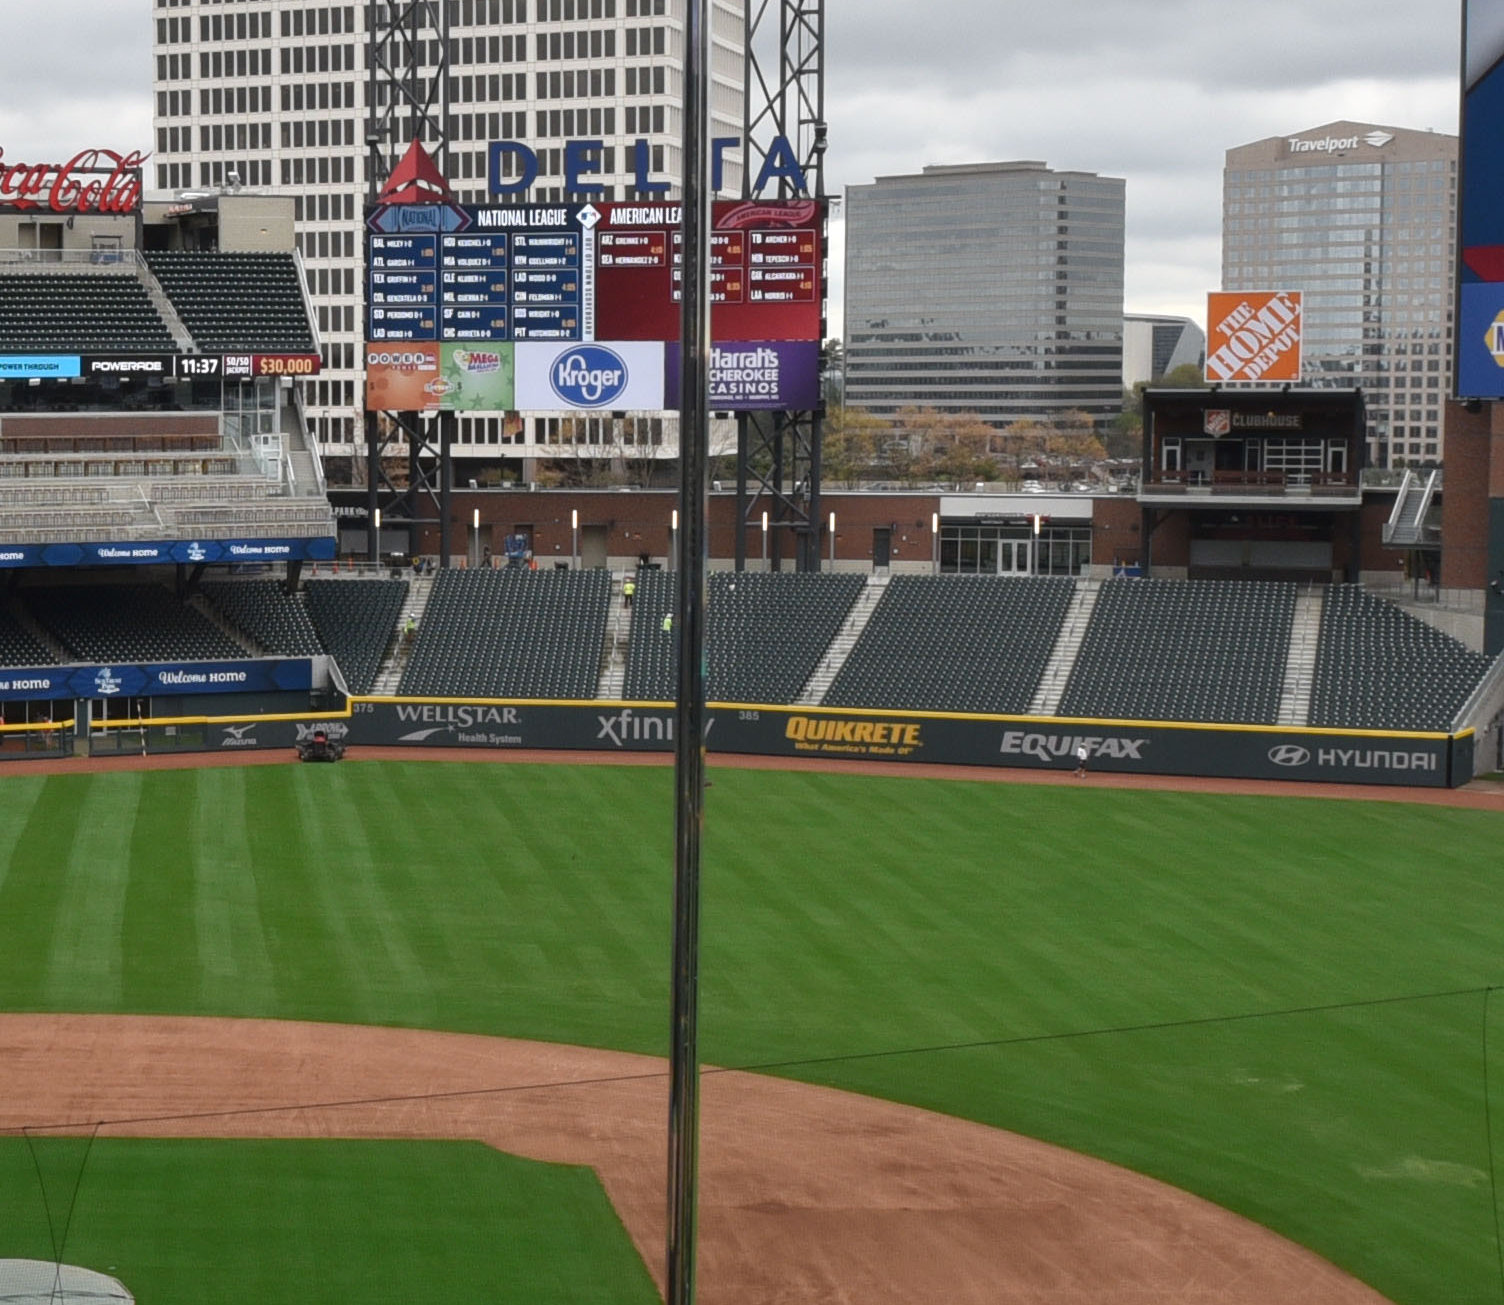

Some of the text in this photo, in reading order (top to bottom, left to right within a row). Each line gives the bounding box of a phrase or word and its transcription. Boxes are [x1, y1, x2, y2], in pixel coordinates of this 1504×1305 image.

[1289, 133, 1358, 154] Travelport
[489, 135, 807, 193] DELTA
[478, 209, 568, 227] NATIONAL LEAGUE
[610, 208, 663, 225] AMERICAN
[1217, 301, 1256, 339] THE
[1206, 292, 1301, 382] HOME
[368, 352, 425, 365] POWER
[469, 351, 499, 364] MEGA
[1242, 325, 1301, 382] DEPOT
[92, 361, 162, 372] POWERADE
[181, 359, 218, 374] 11:37
[226, 356, 313, 375] 50/50 $30,000
[557, 355, 623, 400] Kroger
[709, 369, 779, 382] CHEROKEE
[709, 382, 778, 394] CASINOS
[1232, 415, 1299, 427] CLUBHOUSE
[158, 670, 204, 685] Welcome
[353, 703, 374, 713] 375
[738, 710, 759, 721] 385
[596, 709, 713, 746] xfini
[785, 716, 920, 745] QUIKRETE
[458, 732, 522, 745] Health System
[1000, 731, 1145, 761] EQUIFAX
[1318, 749, 1435, 770] HYUNDAI
